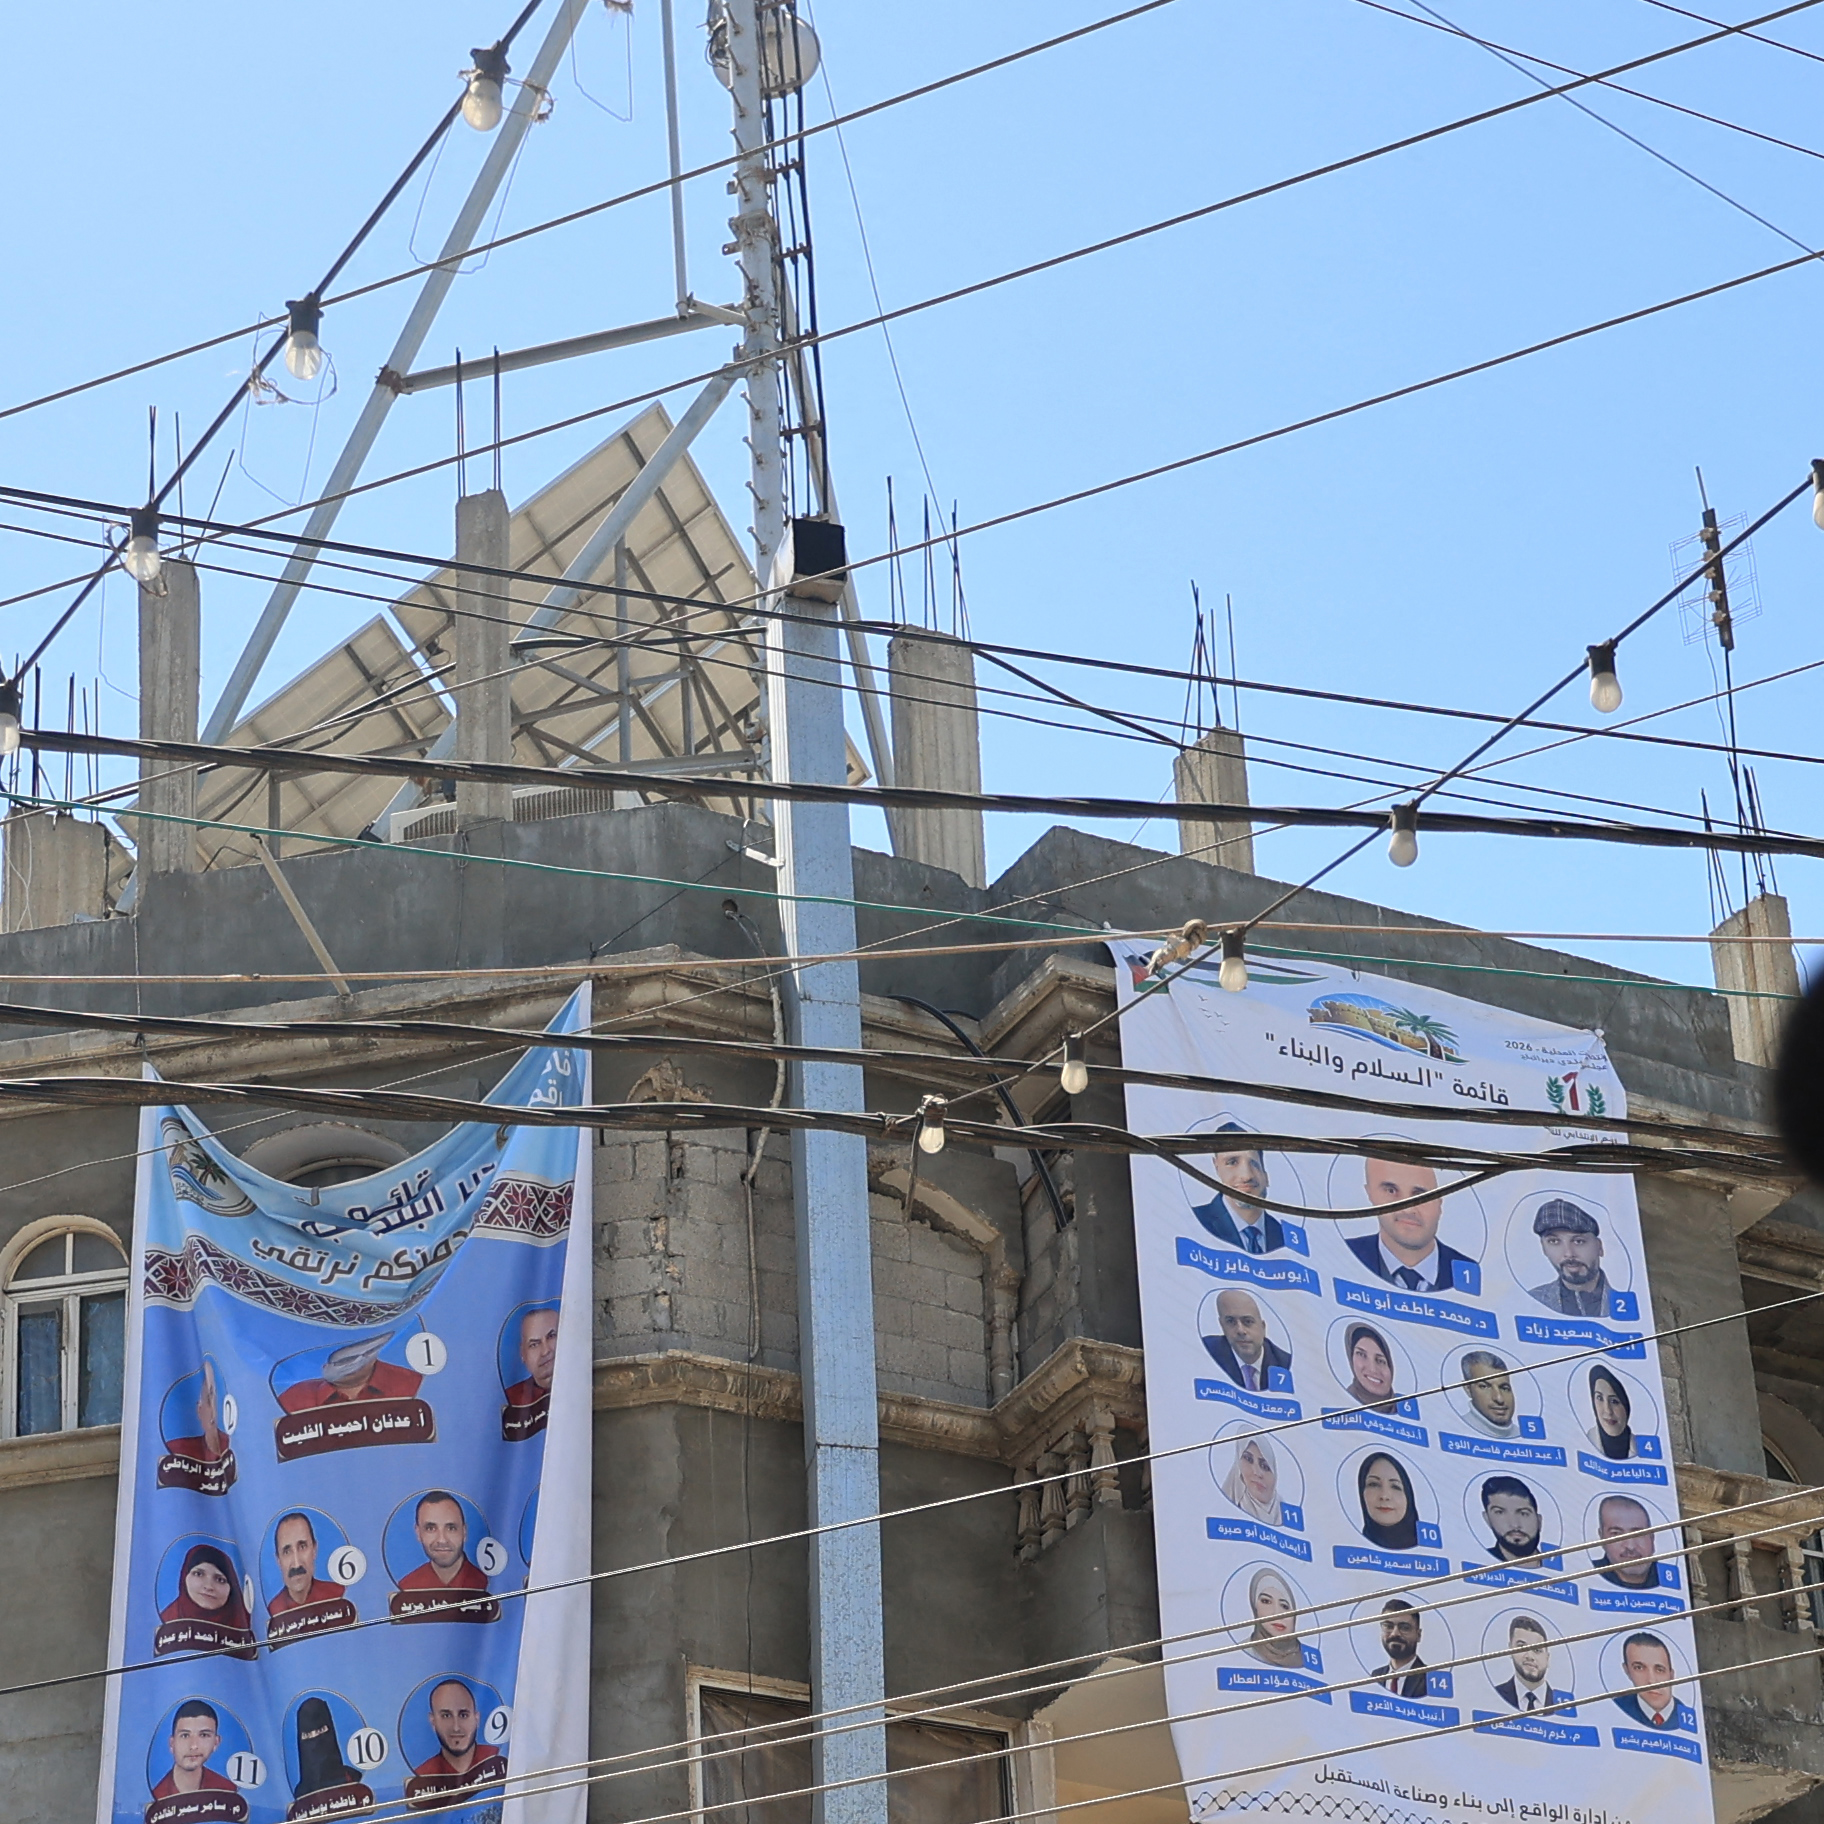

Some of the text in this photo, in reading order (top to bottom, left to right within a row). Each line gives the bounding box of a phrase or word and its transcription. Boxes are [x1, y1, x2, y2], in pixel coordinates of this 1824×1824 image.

[1452, 1078, 1509, 1106] قائمة
[1290, 1230, 1299, 1245] 3
[1463, 1270, 1471, 1284] 1
[1346, 1290, 1370, 1305] ناصر
[1374, 1293, 1391, 1311] أبو
[1615, 1299, 1627, 1313] 2
[1394, 1301, 1436, 1317] عاطف
[1439, 1309, 1471, 1326] محمد
[1525, 1322, 1592, 1340] سعيد زياد
[424, 1338, 436, 1367] 1
[1277, 1373, 1286, 1385] 7
[1403, 1401, 1412, 1412] 6
[371, 1414, 411, 1432] عدنان
[1527, 1421, 1536, 1432] 5
[1645, 1441, 1653, 1452] 4
[1284, 1509, 1298, 1522] 11
[1421, 1528, 1437, 1541] 10
[338, 1550, 356, 1581] 6
[483, 1543, 496, 1571] 5
[1665, 1569, 1673, 1582] 8
[1303, 1651, 1319, 1665] 15
[1430, 1677, 1448, 1690] 14
[490, 1710, 506, 1741] 9
[1681, 1712, 1694, 1726] 12
[355, 1732, 385, 1764] 10
[234, 1755, 260, 1786] 11
[1314, 1764, 1391, 1795] المستقبل
[1394, 1784, 1448, 1809] وصناعة
[1453, 1791, 1482, 1809] بناء
[1486, 1798, 1515, 1819] إلى
[1519, 1801, 1569, 1820] الواقع
